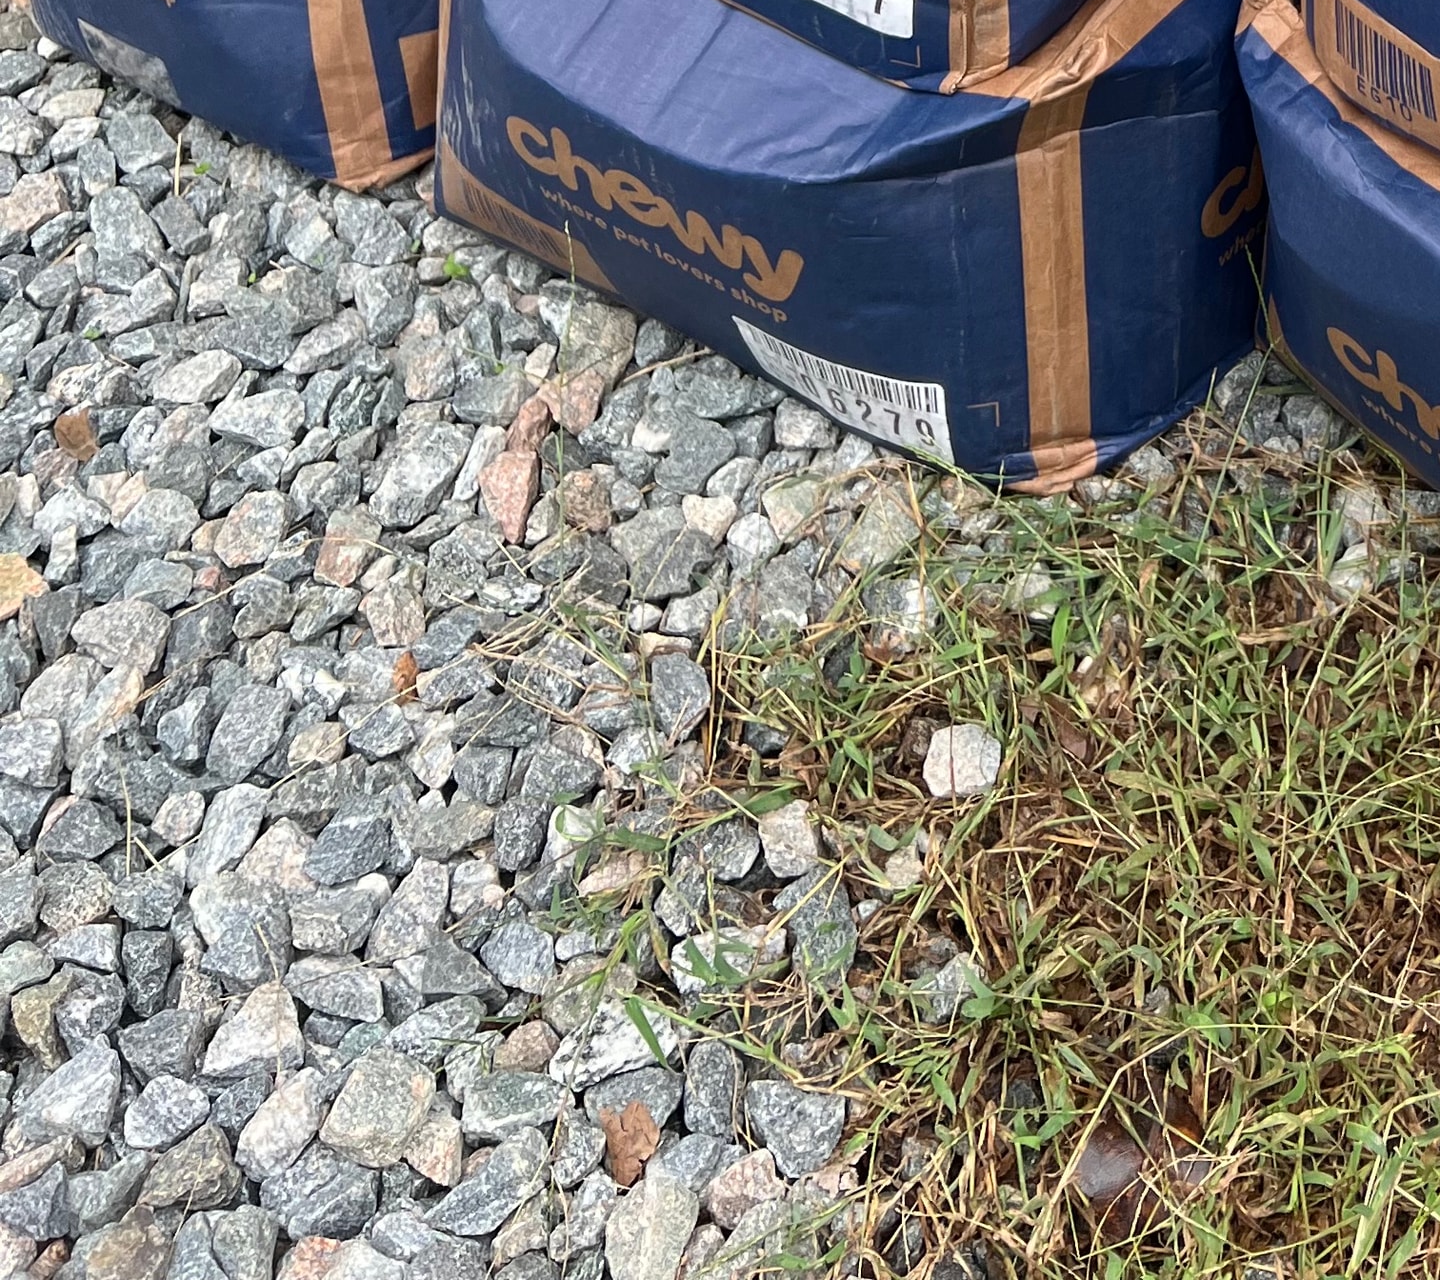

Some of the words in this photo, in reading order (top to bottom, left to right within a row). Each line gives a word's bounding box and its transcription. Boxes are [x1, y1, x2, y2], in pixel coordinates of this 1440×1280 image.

[506, 115, 805, 302] chewy
[540, 183, 608, 234] where
[613, 227, 652, 255] pet
[655, 244, 725, 294] lovers
[730, 284, 788, 323] shop
[1360, 394, 1433, 456] where
